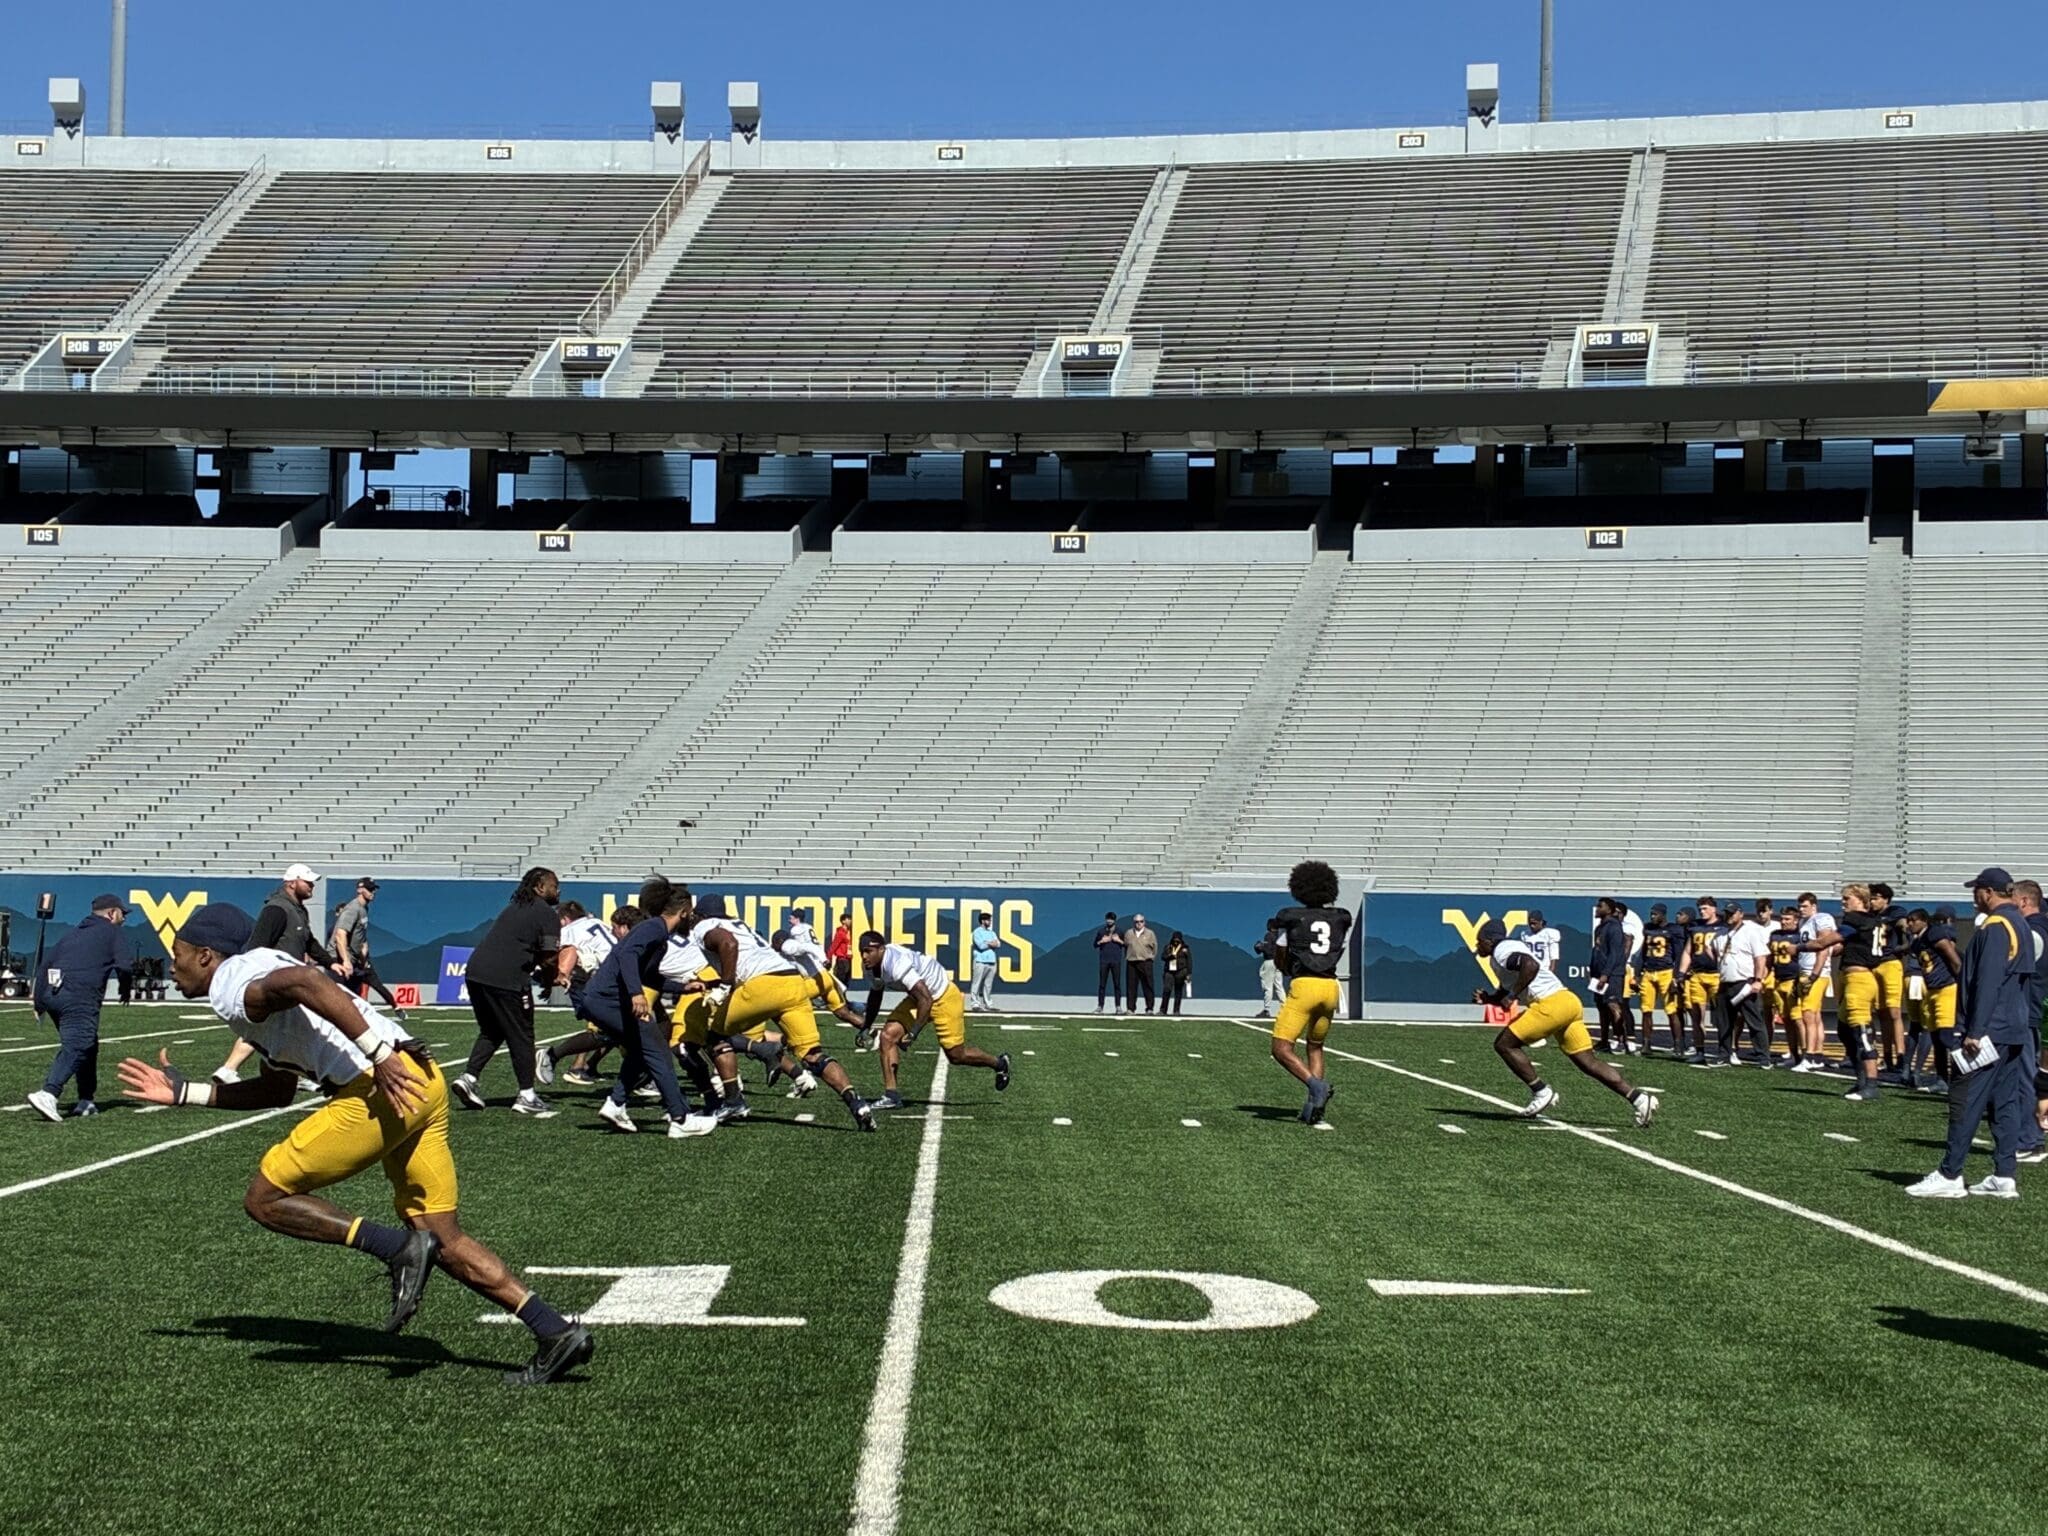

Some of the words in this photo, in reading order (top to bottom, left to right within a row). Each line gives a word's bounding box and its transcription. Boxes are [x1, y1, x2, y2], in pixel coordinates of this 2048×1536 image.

[1889, 117, 1909, 126] 202
[1402, 137, 1421, 147] 203
[490, 149, 508, 158] 205
[941, 149, 960, 159] 204
[1589, 334, 1612, 344] 203
[1622, 333, 1645, 343] 202
[67, 341, 89, 352] 206
[98, 341, 120, 352] 205
[566, 346, 588, 356] 205
[597, 346, 619, 356] 204
[1067, 345, 1089, 356] 204
[1098, 344, 1120, 355] 203
[34, 530, 53, 541] 105
[1596, 533, 1617, 544] 102
[545, 537, 565, 548] 104
[1060, 537, 1080, 548] 103
[1310, 921, 1330, 954] 3
[397, 987, 415, 1003] 20
